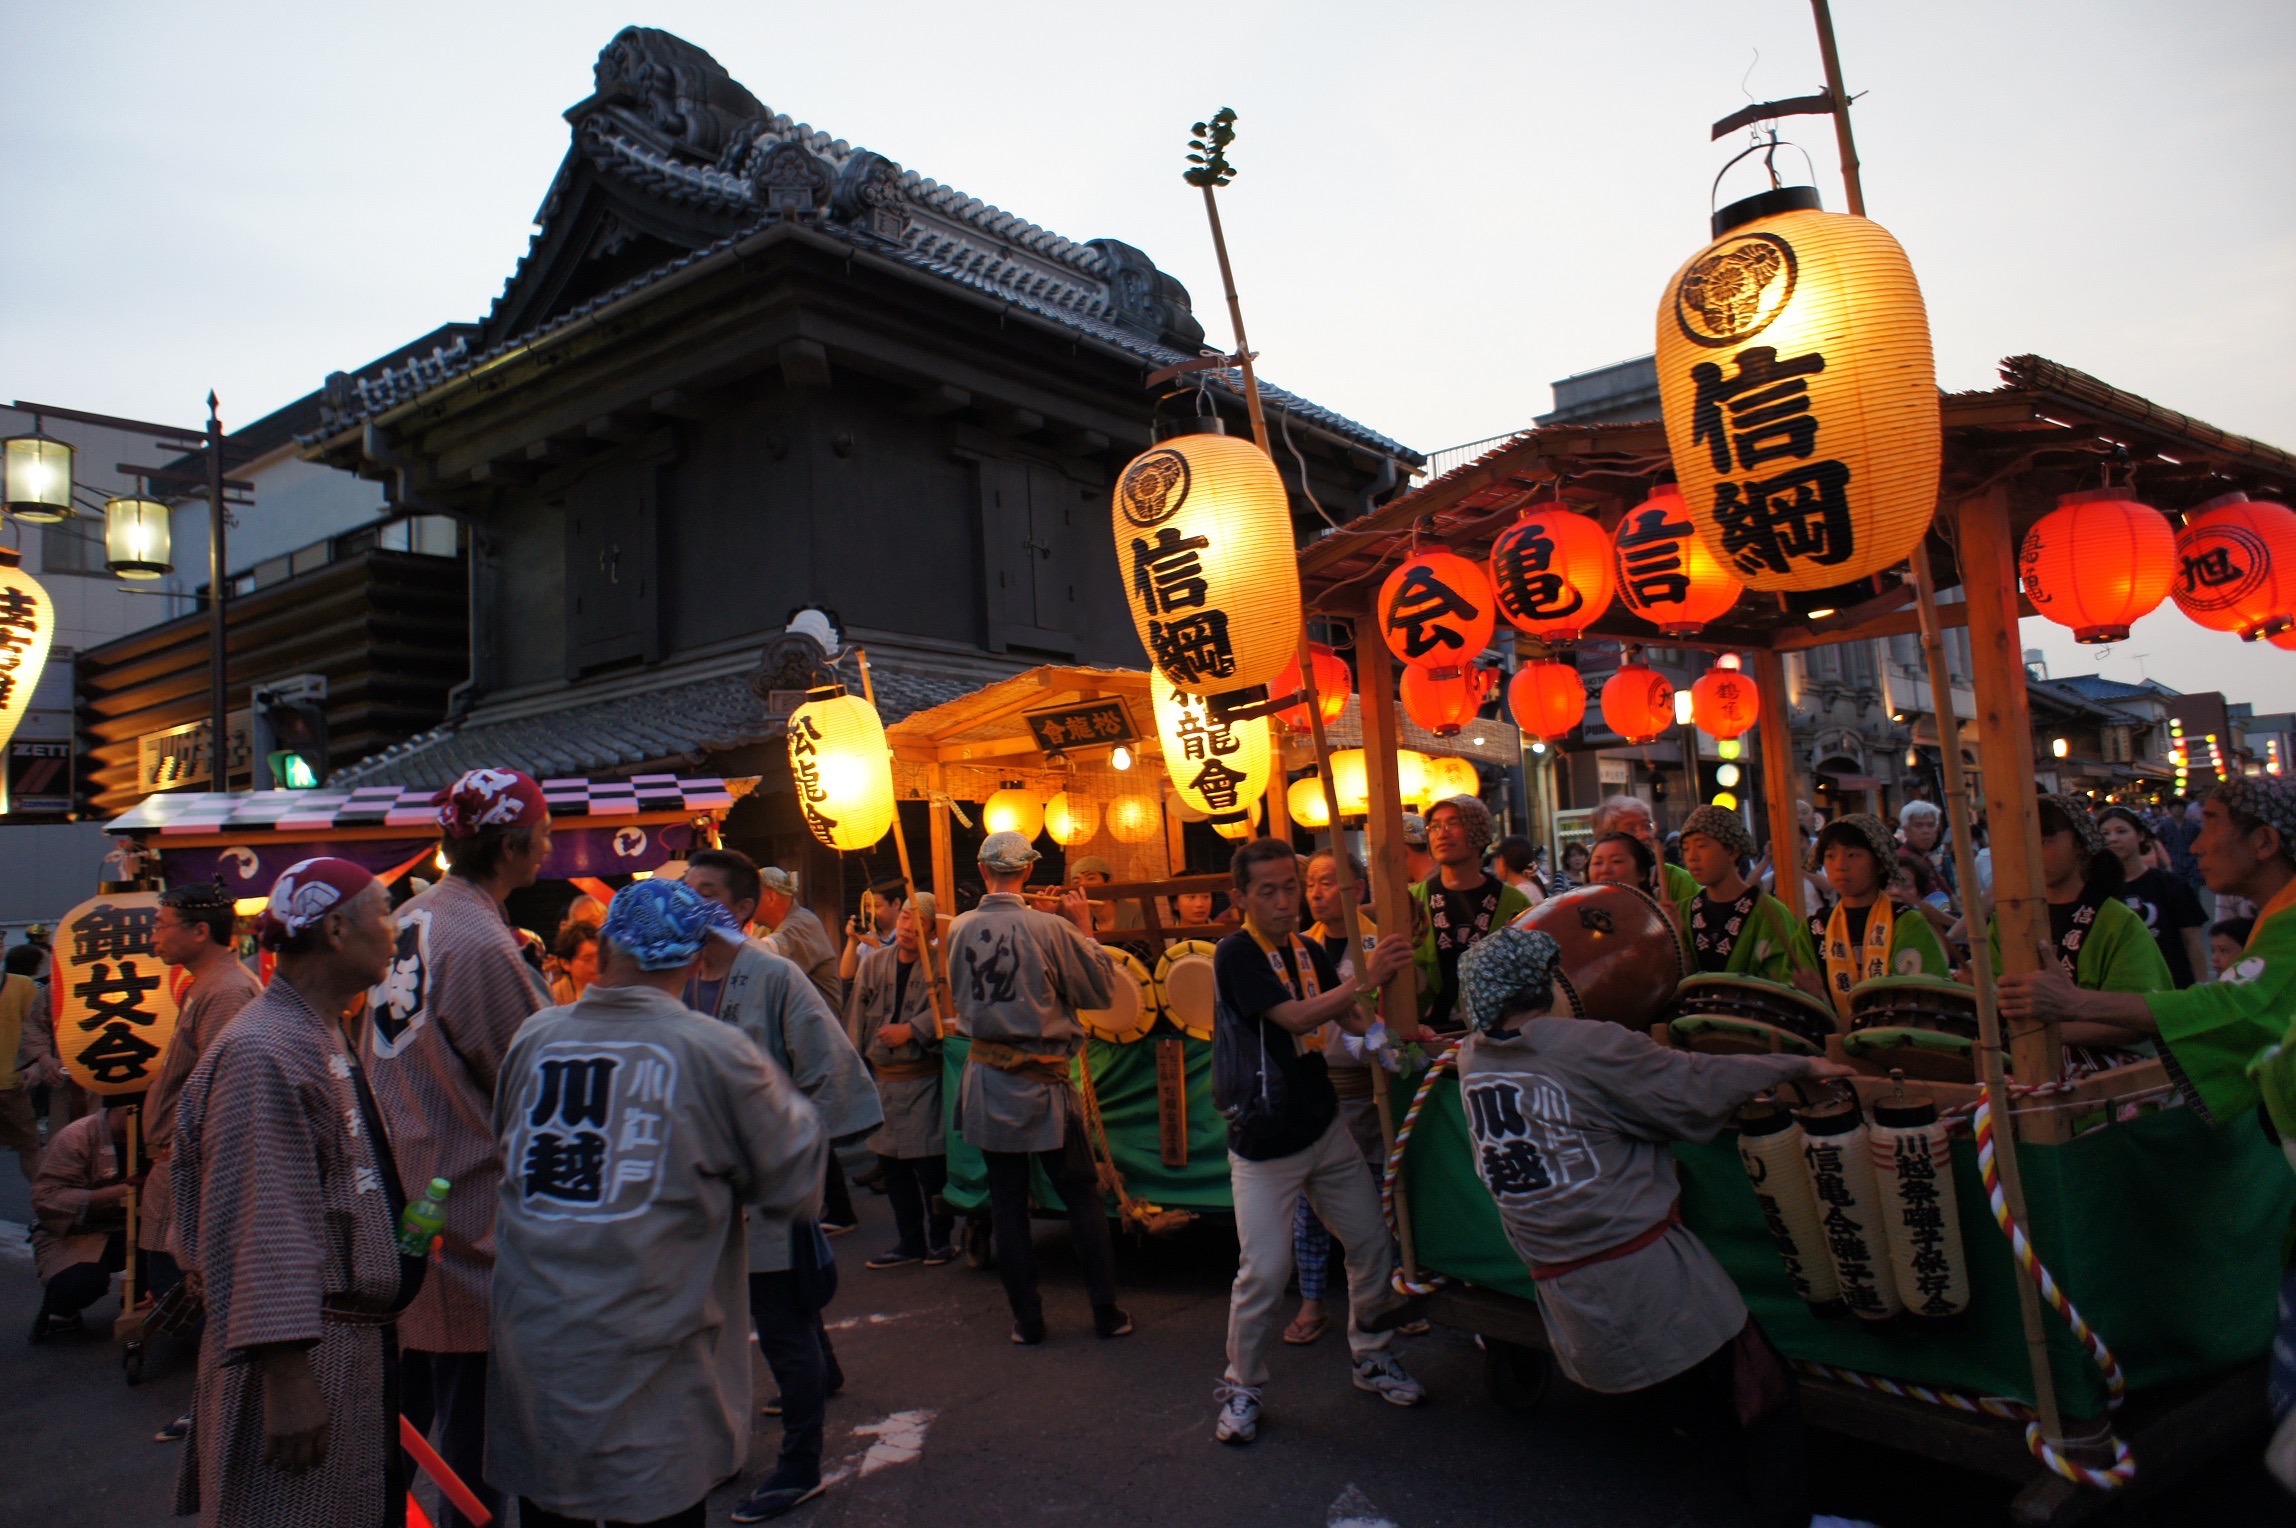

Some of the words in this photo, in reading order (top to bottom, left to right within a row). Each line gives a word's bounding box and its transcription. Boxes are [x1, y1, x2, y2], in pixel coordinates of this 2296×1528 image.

[1691, 345, 1854, 576] 信綱
[1131, 528, 1237, 685] 信綱
[1387, 566, 1479, 659] 会
[1494, 524, 1584, 620] 亀
[1616, 509, 1695, 609] 信
[13, 742, 70, 757] ZETT
[524, 1055, 621, 1205] 川越
[607, 1058, 667, 1204] 小江戸
[1465, 1080, 1553, 1198] 川越
